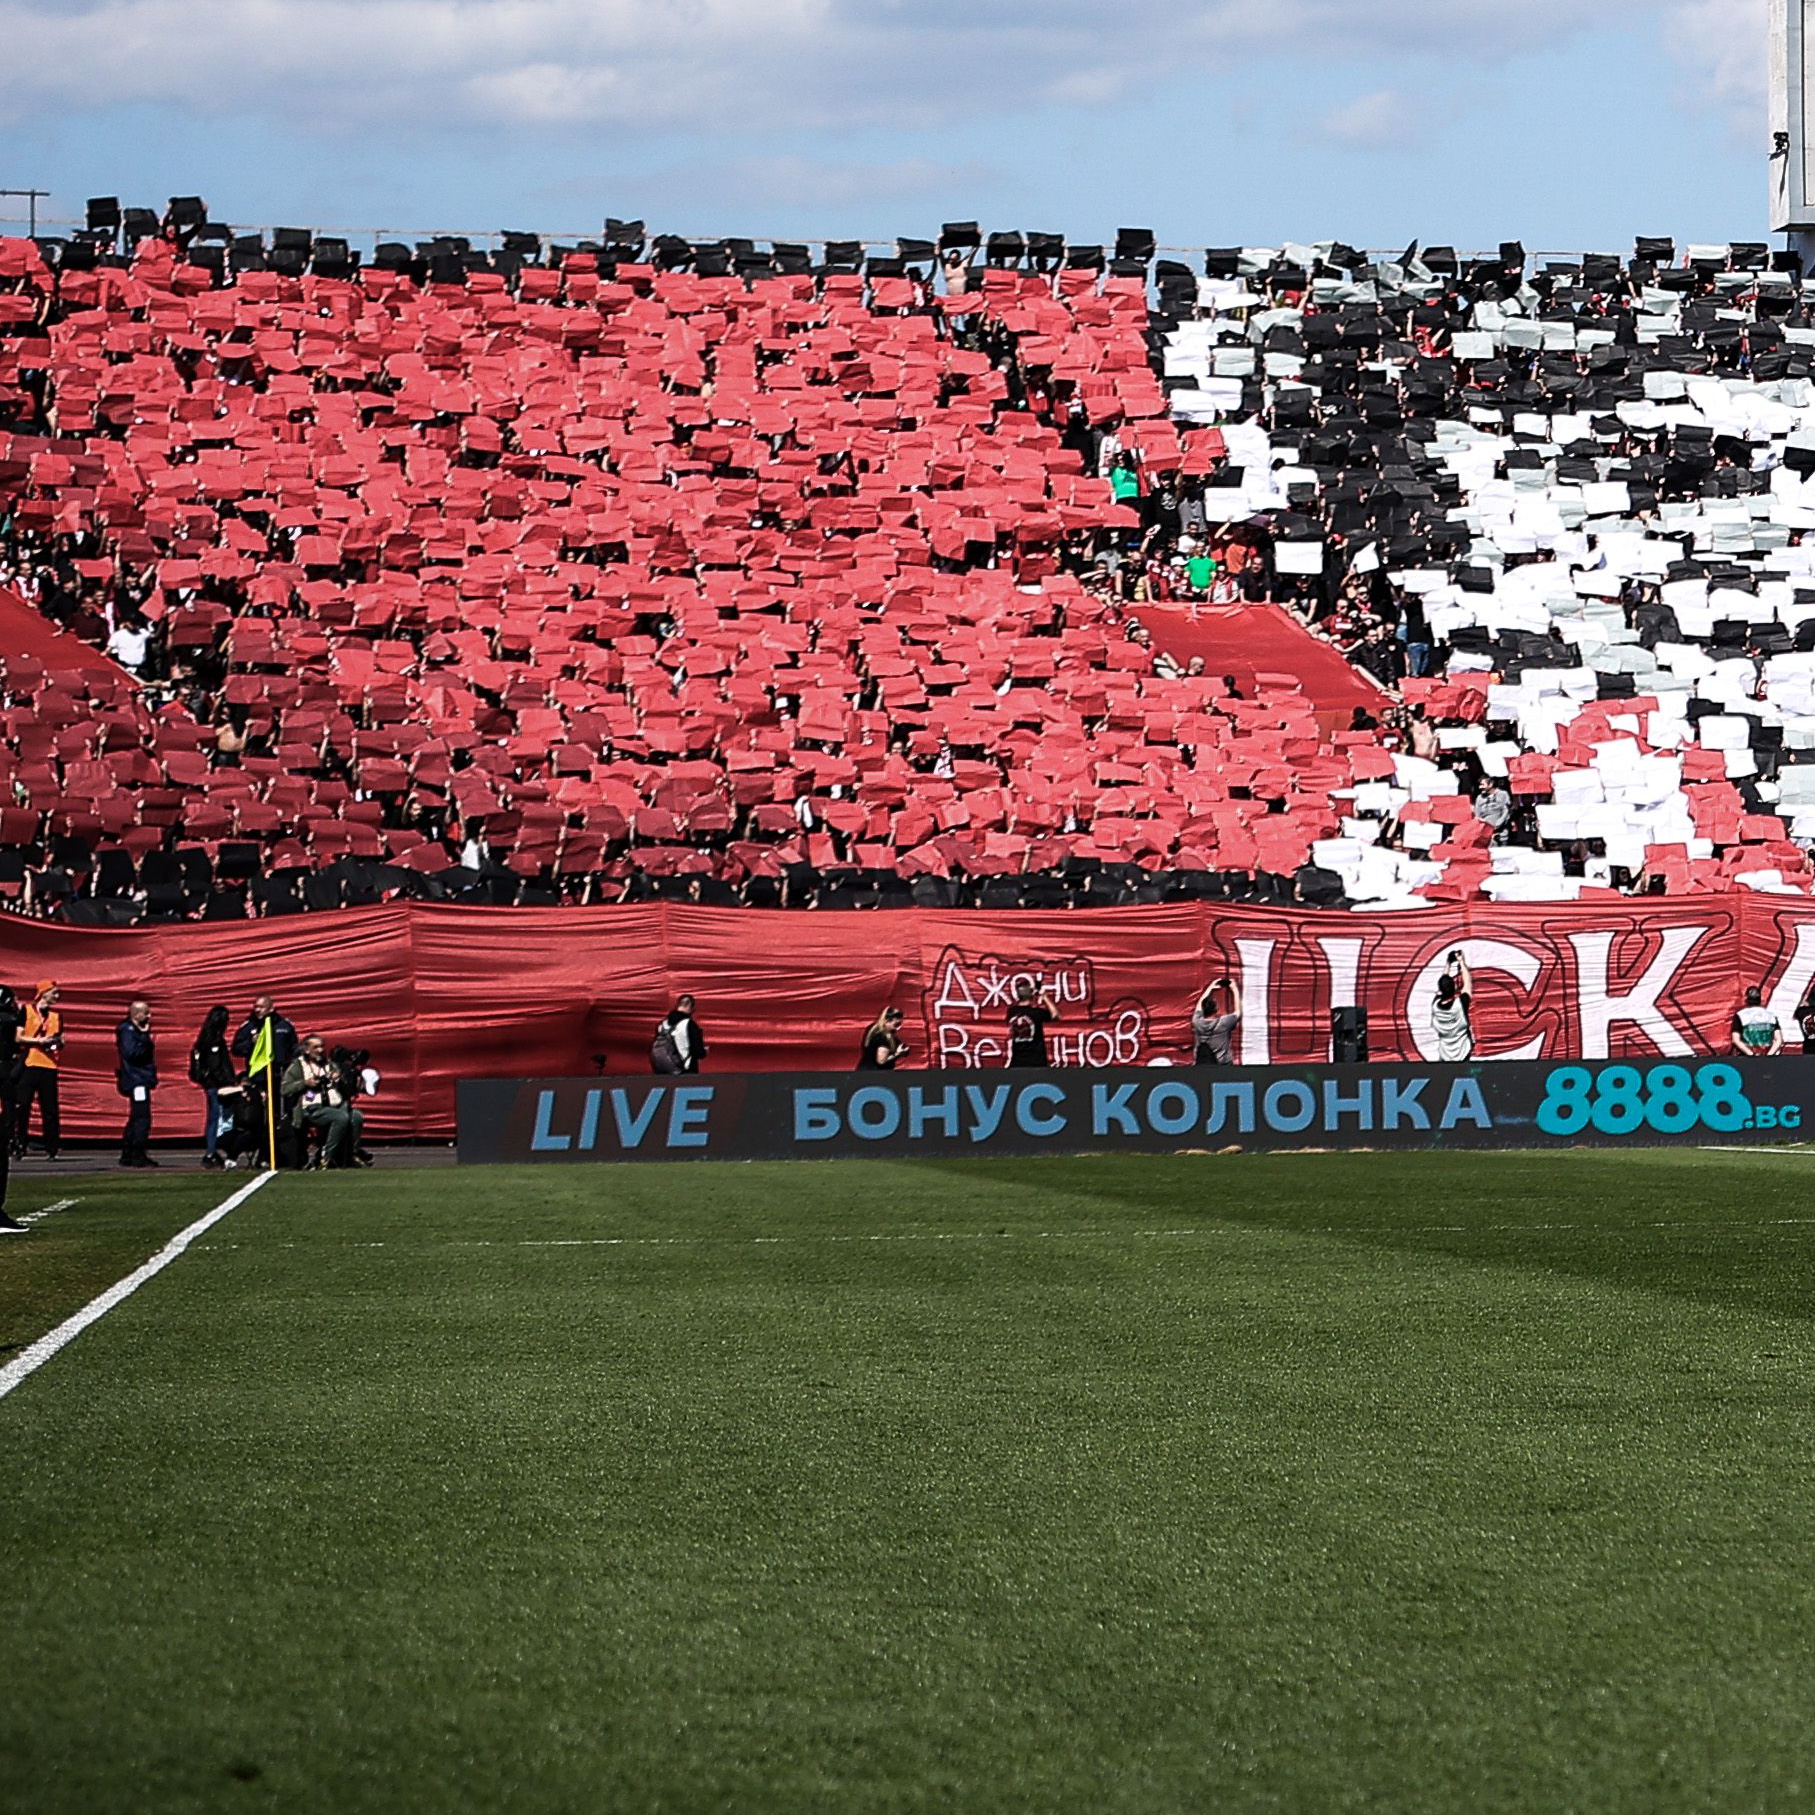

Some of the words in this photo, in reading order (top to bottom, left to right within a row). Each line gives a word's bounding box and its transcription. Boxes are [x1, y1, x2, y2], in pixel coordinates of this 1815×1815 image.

[938, 1010, 1141, 1070] Венов
[531, 1086, 715, 1152] LIVE
[794, 1083, 1067, 1142] БОНУС
[1092, 1077, 1494, 1136] КОЛОНКА
[1536, 1063, 1801, 1135] 8888.BG
